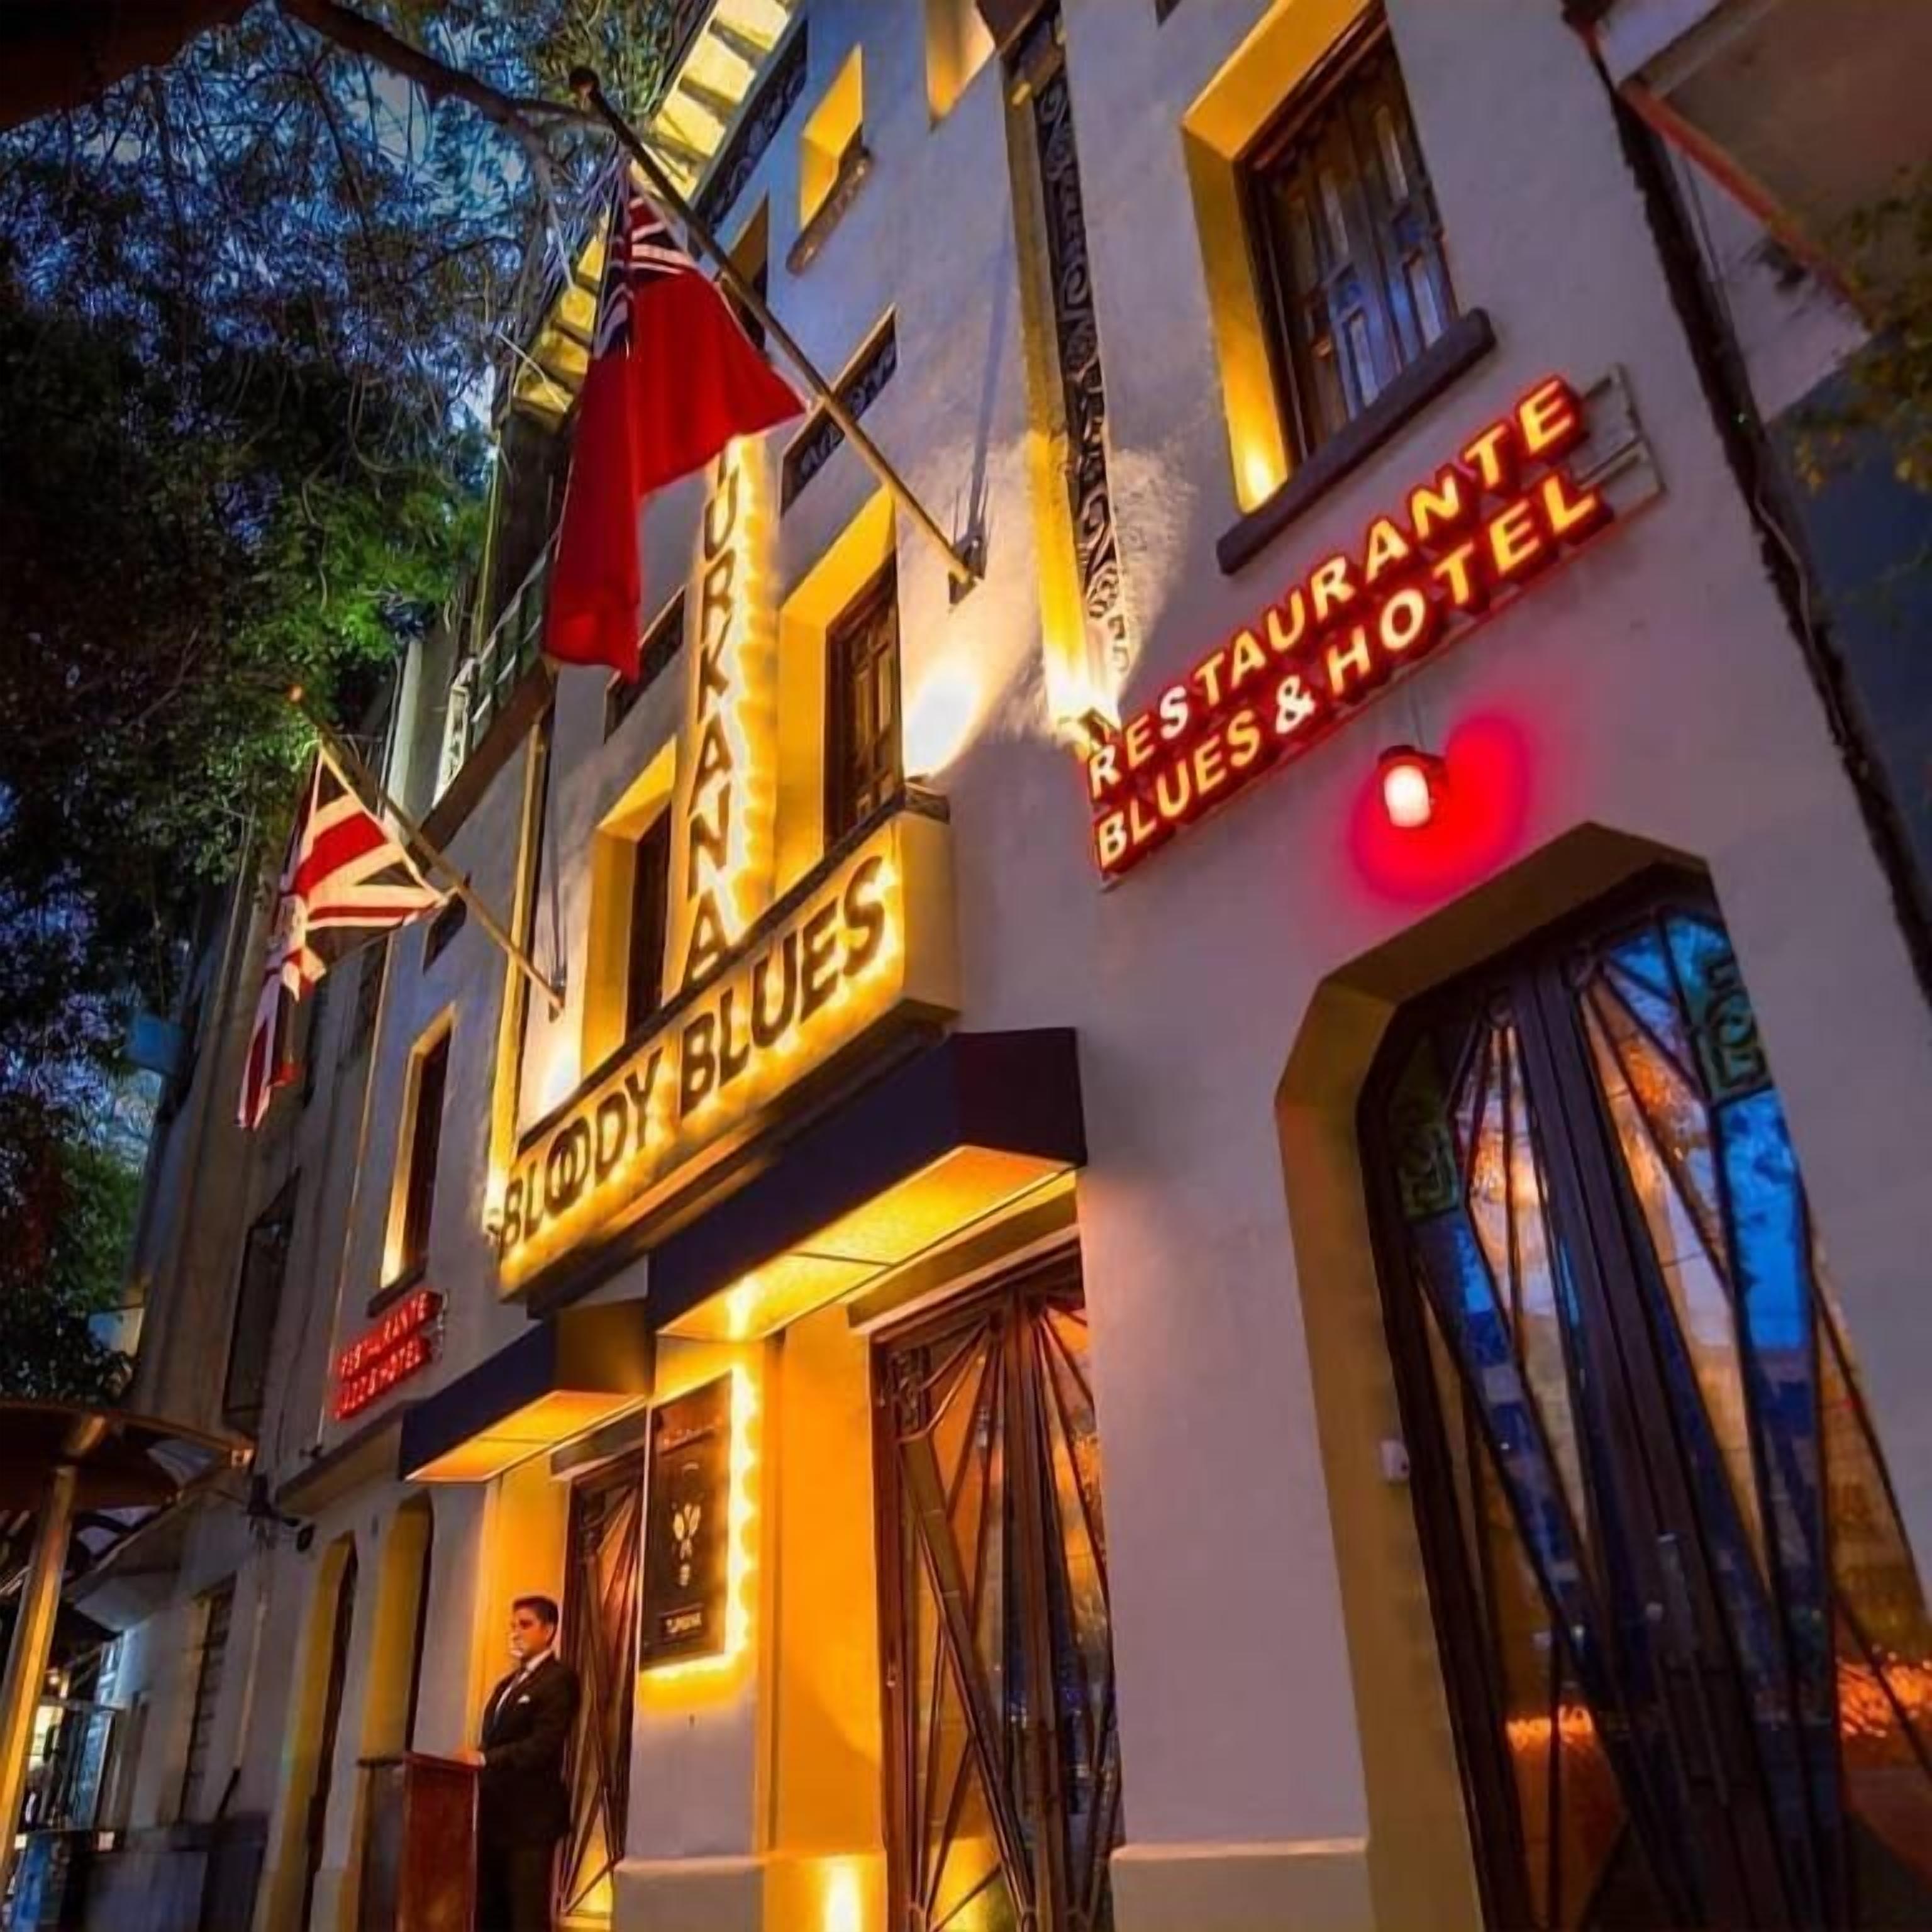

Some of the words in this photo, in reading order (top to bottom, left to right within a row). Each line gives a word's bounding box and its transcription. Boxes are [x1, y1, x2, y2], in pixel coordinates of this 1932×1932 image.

[684, 453, 741, 987] URKANA
[1089, 379, 1576, 799] RESTAURANTE
[502, 1048, 663, 1249] BLOODY
[680, 855, 893, 1117] BLUES
